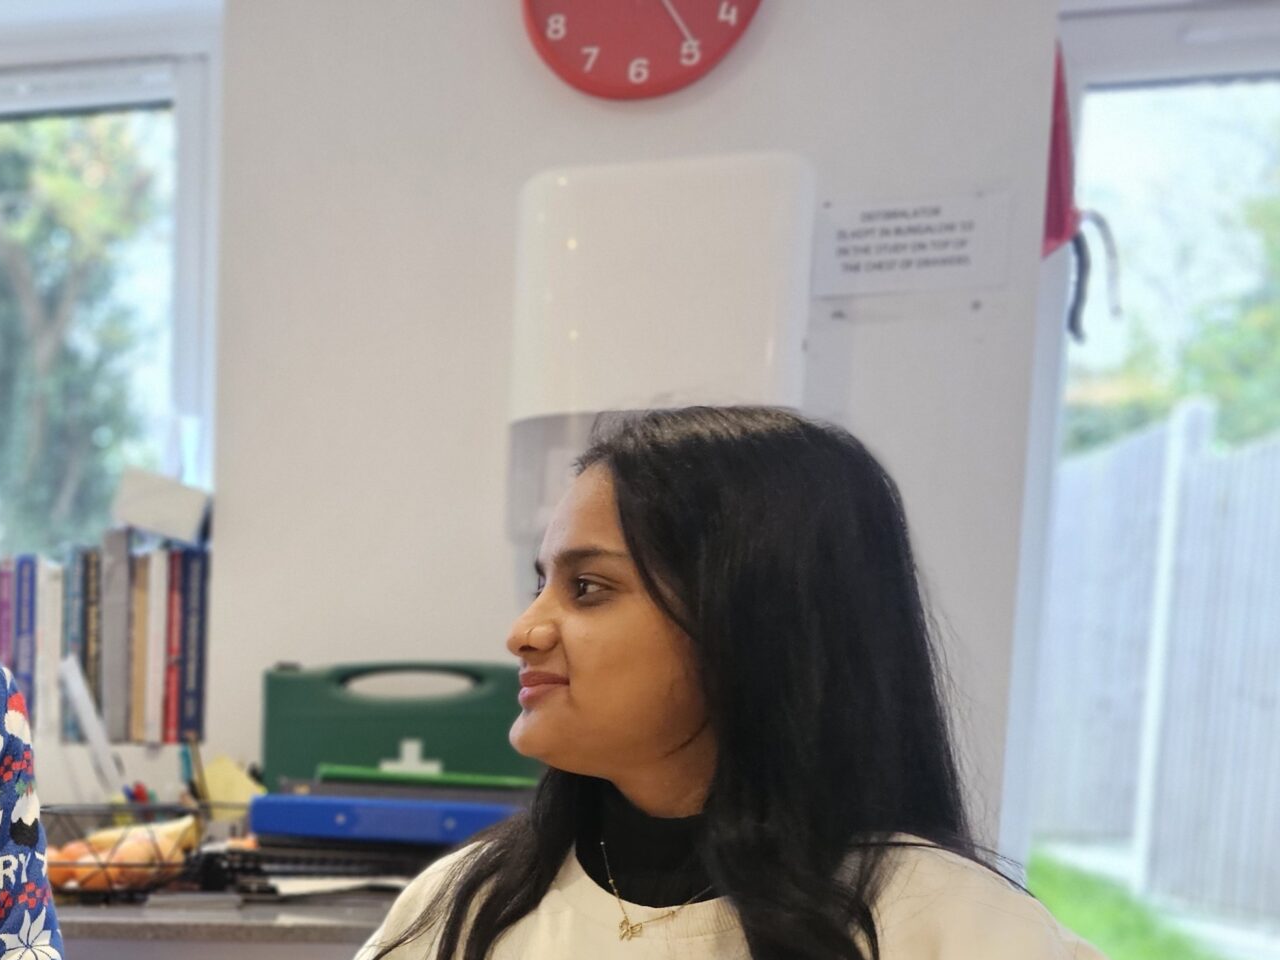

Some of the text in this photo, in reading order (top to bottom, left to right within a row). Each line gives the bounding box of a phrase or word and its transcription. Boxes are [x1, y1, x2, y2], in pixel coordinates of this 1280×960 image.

[546, 13, 566, 40] 8
[718, 1, 739, 26] 4
[581, 46, 600, 73] 7
[680, 39, 701, 66] 5
[628, 57, 649, 84] 6
